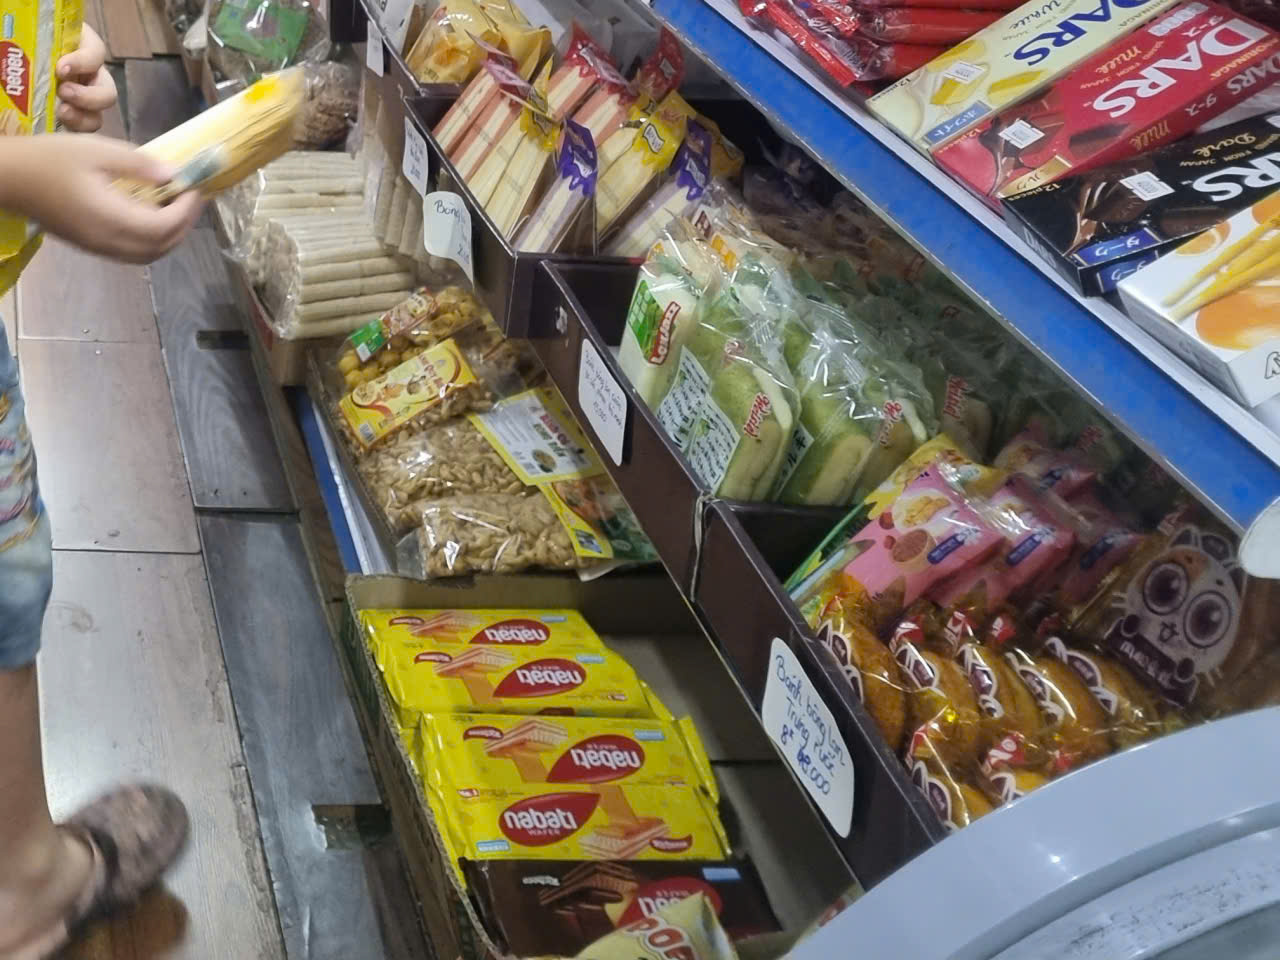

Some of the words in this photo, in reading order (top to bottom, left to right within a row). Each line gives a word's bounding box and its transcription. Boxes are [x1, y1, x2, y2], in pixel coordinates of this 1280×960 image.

[1181, 14, 1224, 38] ダース
[5, 46, 25, 96] nabati
[1092, 17, 1271, 119] DARS
[1095, 45, 1143, 74] Milk
[1184, 92, 1217, 117] ダース
[1128, 119, 1171, 151] Milk
[1192, 131, 1257, 157] Dark
[1094, 235, 1141, 258] ダーク
[483, 625, 548, 646] nabati
[515, 666, 585, 687] nabati
[570, 747, 642, 770] nabati
[503, 806, 579, 830] nabati
